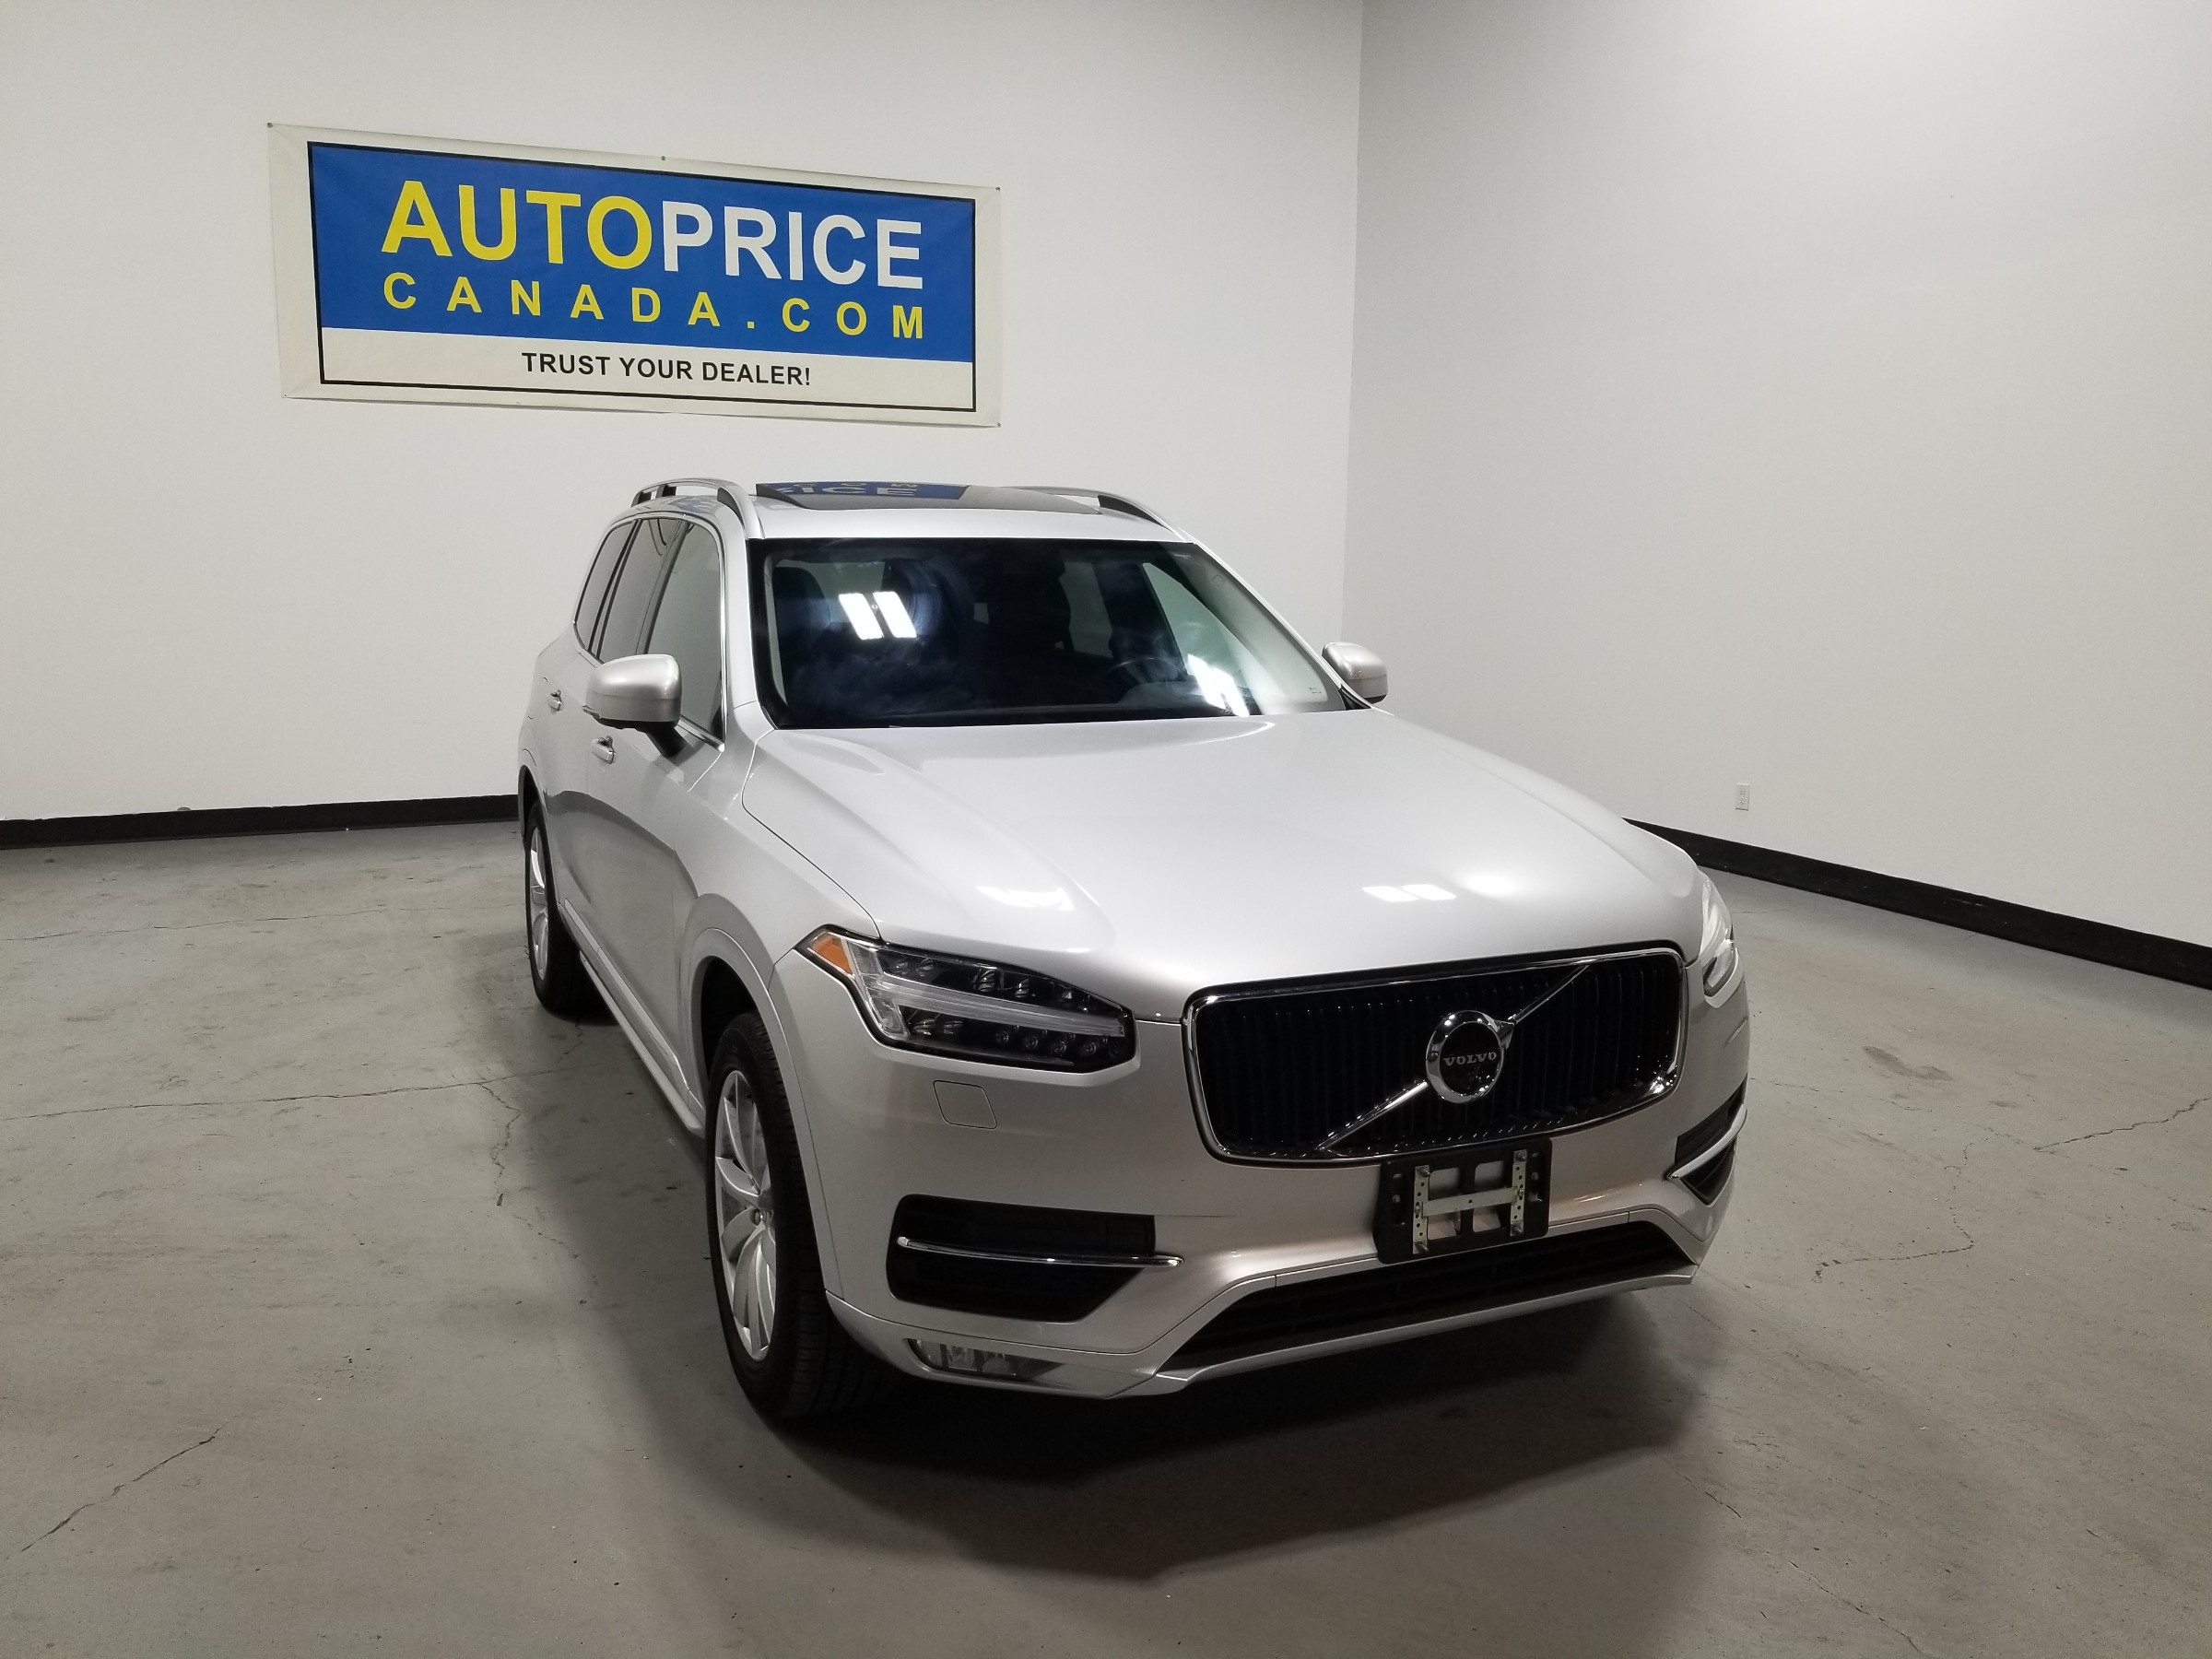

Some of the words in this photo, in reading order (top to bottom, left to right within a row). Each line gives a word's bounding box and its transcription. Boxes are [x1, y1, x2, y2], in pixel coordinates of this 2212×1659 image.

[381, 180, 924, 289] AUTOPRICE
[383, 271, 923, 339] CANADA.COM
[522, 352, 611, 376] TRUST
[618, 357, 694, 381] YOUR
[702, 361, 810, 386] DEALER!
[1443, 1051, 1497, 1066] VOLVO
